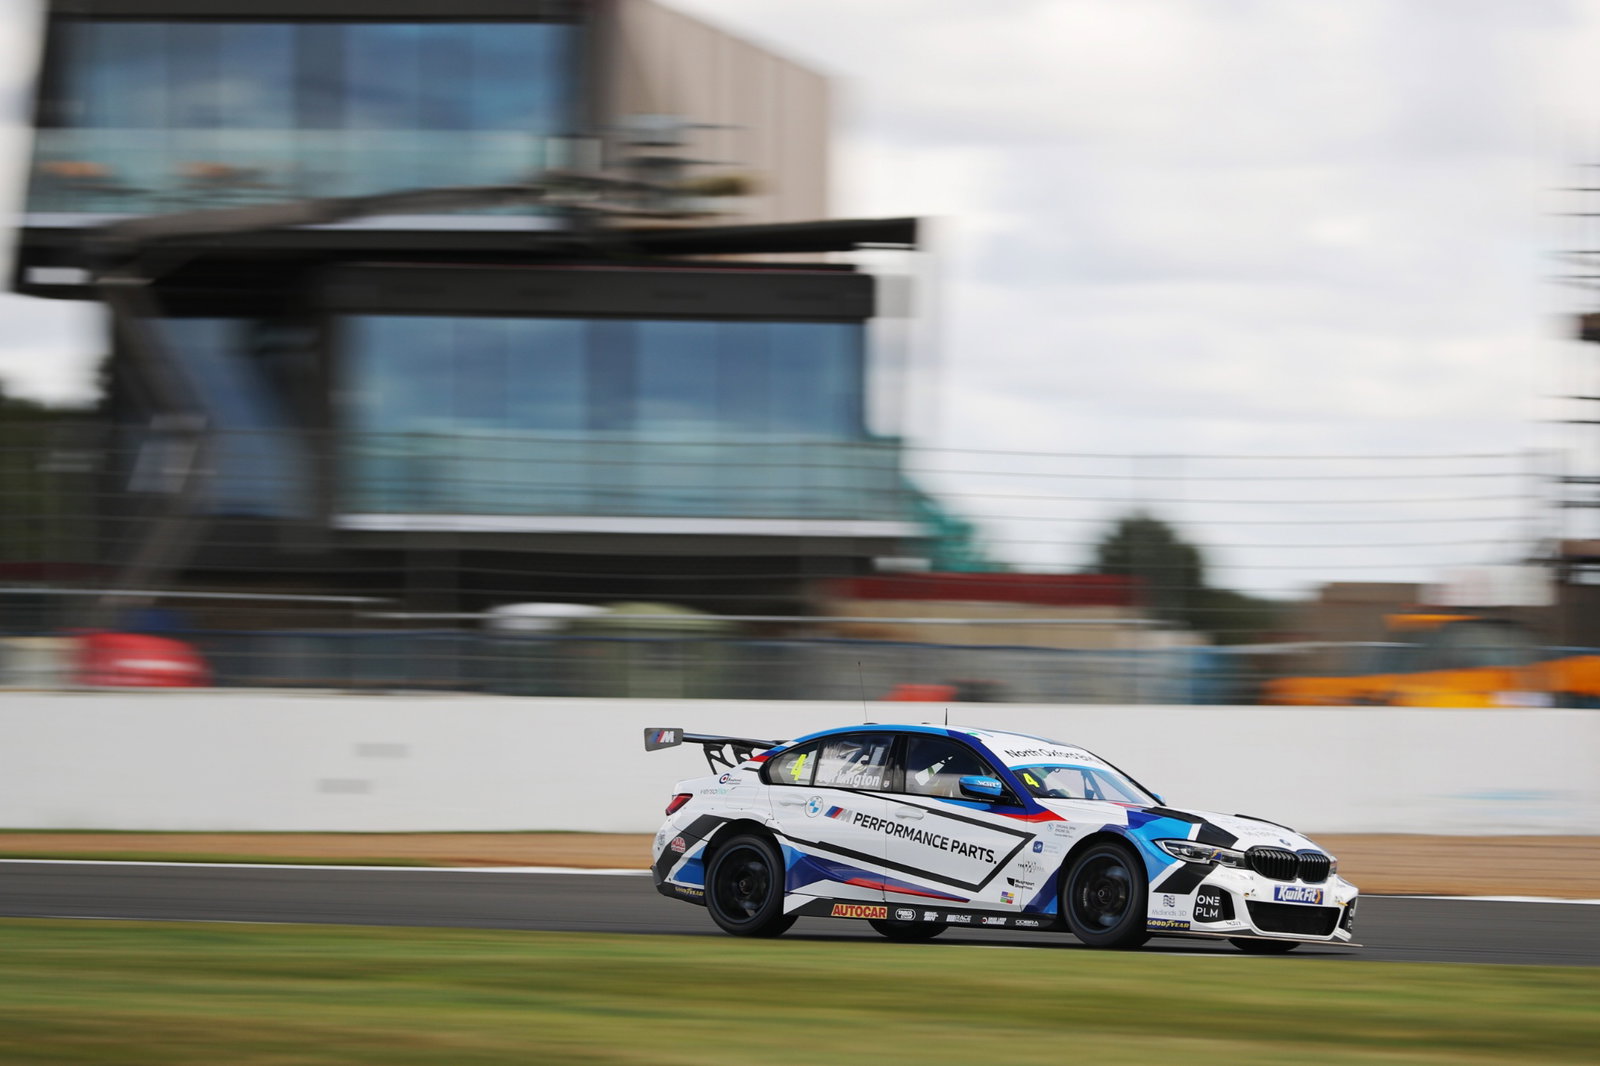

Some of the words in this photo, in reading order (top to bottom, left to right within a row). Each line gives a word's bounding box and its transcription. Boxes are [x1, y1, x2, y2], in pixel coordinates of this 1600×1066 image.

[1004, 747, 1039, 758] North
[791, 754, 808, 781] 4
[1023, 773, 1040, 788] 4
[853, 812, 948, 852] PERFORMANCE
[950, 840, 998, 865] PARTS.
[1196, 895, 1221, 906] ONE
[832, 904, 887, 919] AUTOCAR
[1195, 907, 1219, 918] PLM
[1146, 919, 1190, 929] GOODYEAR
